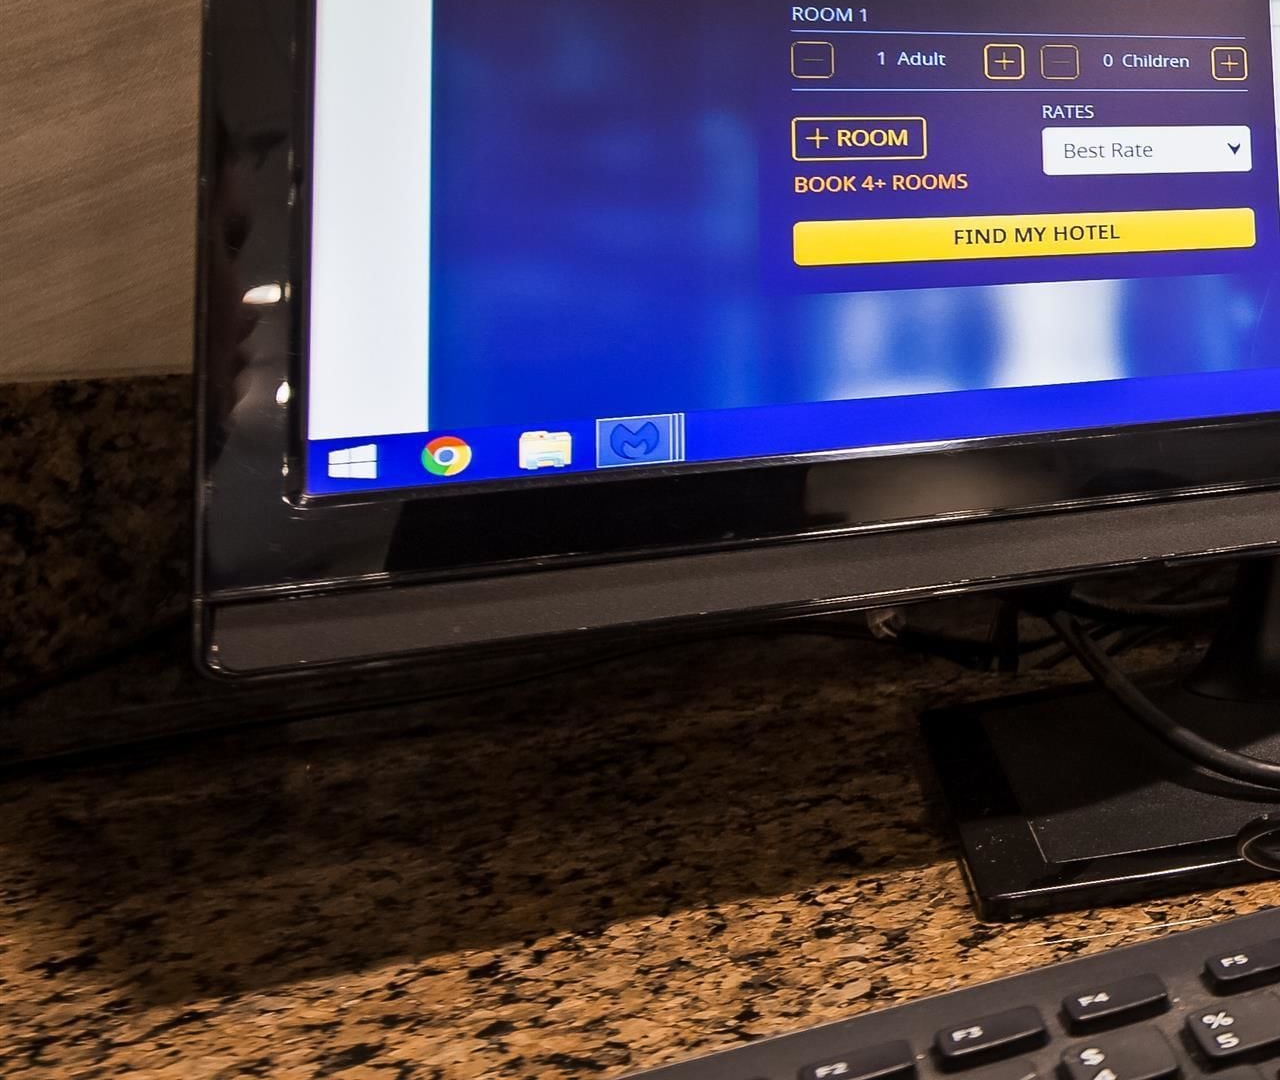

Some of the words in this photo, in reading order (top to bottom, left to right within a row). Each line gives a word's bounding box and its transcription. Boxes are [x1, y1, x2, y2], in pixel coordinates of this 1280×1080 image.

[791, 7, 853, 22] ROOM
[859, 7, 868, 22] 1
[877, 51, 886, 66] 1
[897, 51, 946, 67] Adult
[1103, 54, 1113, 68] 0
[1122, 53, 1190, 69] Children
[1042, 104, 1094, 119] RATES
[837, 129, 909, 147] ROOM
[1064, 141, 1106, 159] Best
[1111, 141, 1153, 159] Rate
[794, 176, 856, 193] BOOK
[861, 175, 887, 192] 4+
[892, 173, 969, 191] ROOMS
[954, 227, 1007, 245] FIND
[1014, 226, 1047, 243] MY
[1053, 224, 1120, 241] HOTEL
[1220, 954, 1249, 968] F5
[1078, 992, 1110, 1007] F4
[952, 1025, 983, 1043] F3
[1216, 1033, 1240, 1049] 5
[815, 1061, 848, 1079] F2
